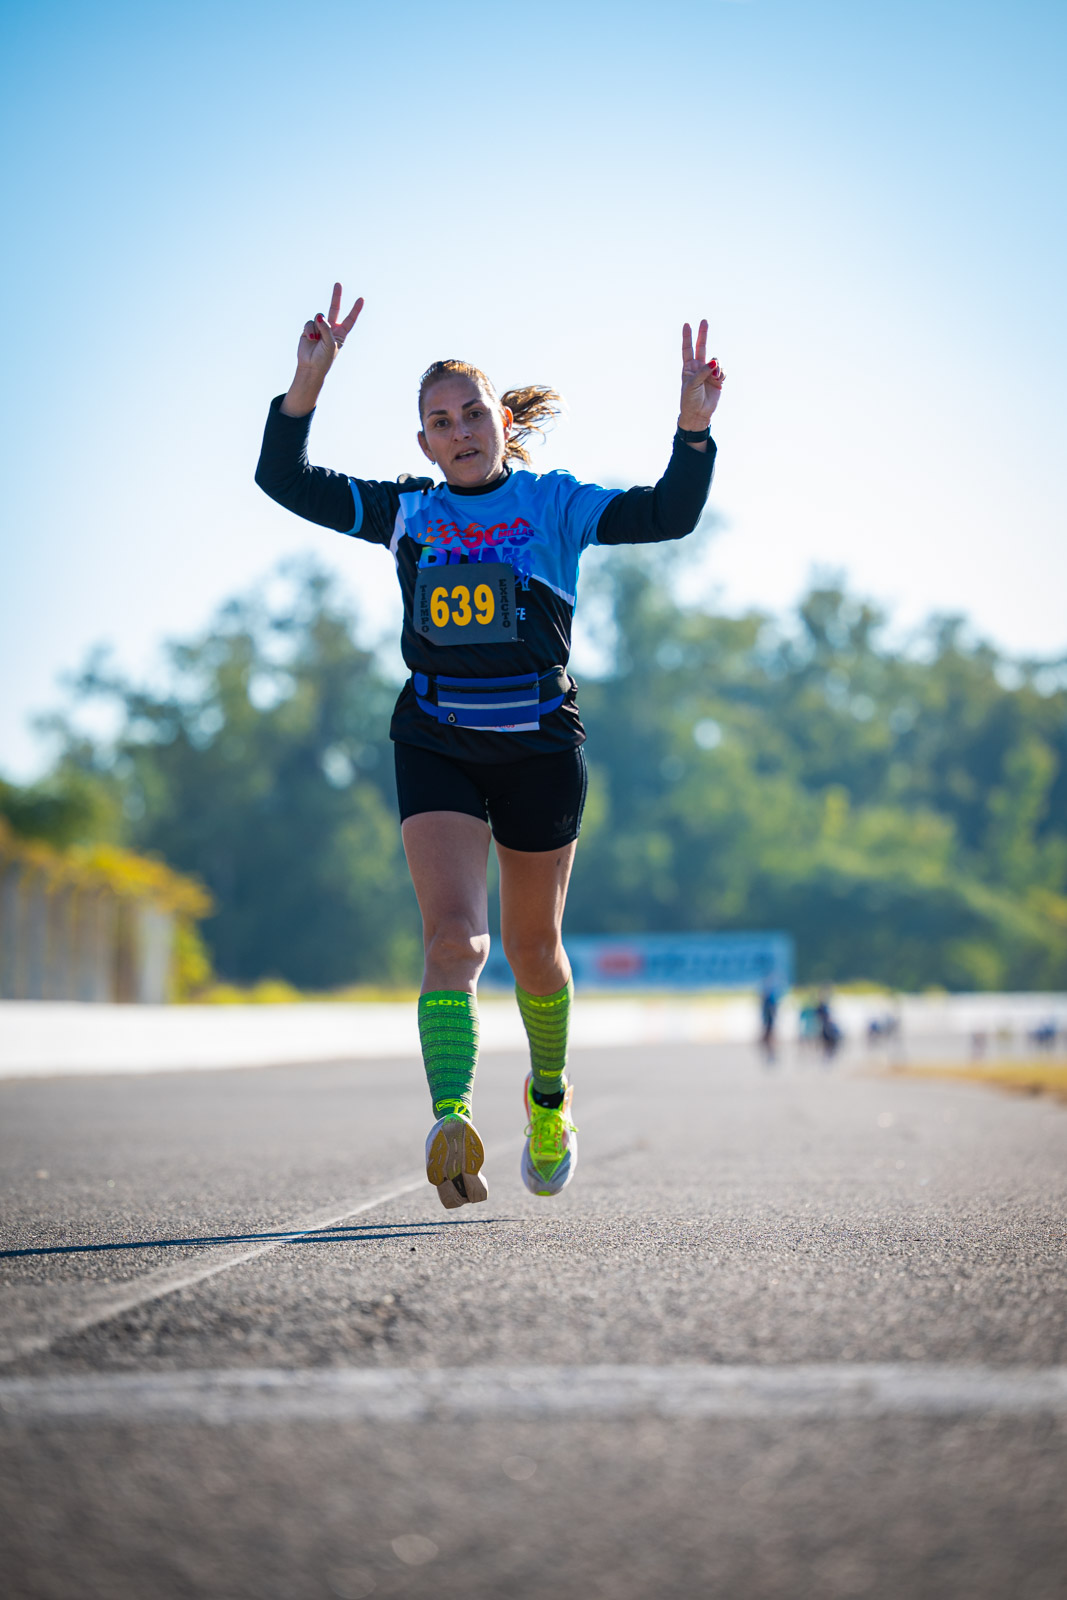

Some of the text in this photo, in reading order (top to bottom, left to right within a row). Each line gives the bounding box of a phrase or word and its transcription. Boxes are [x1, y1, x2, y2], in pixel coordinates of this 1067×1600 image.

[498, 528, 534, 538] MILLAS
[420, 584, 430, 633] TIEMPO
[430, 583, 495, 628] 639
[499, 578, 511, 628] EXACTO
[426, 999, 467, 1008] SOX
